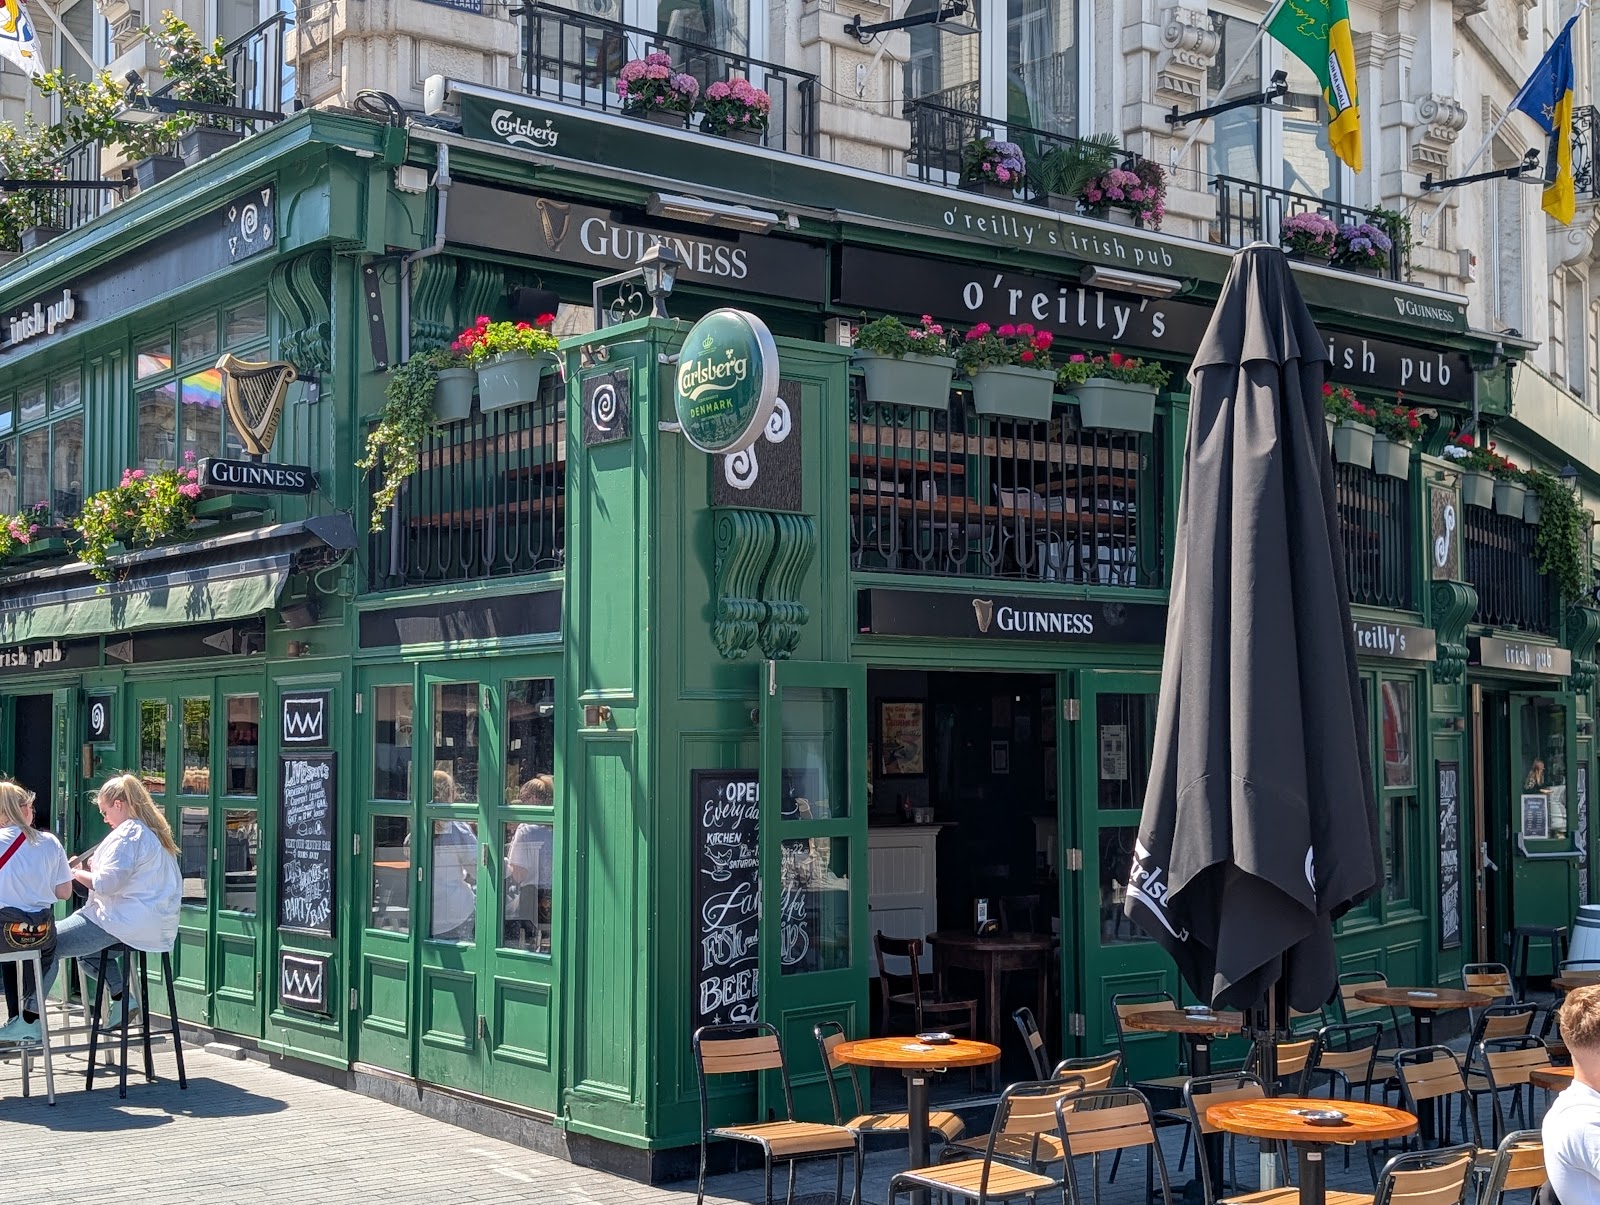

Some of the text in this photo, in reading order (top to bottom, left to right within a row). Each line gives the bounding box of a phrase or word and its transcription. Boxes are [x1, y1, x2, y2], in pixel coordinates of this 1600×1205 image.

[490, 108, 559, 147] Carlsberg
[944, 206, 1173, 267] o'reilly's irish pub
[10, 289, 75, 344] irish pub
[963, 274, 1166, 340] o'reilly's
[1405, 301, 1454, 323] GUINNESS
[1328, 337, 1451, 386] ish pub
[678, 356, 748, 401] Carlsberg
[690, 398, 733, 418] DENMARK
[212, 462, 305, 487] GUINNESS
[997, 606, 1093, 634] GUINNESS
[1353, 623, 1406, 655] 'reilly's
[0, 640, 62, 668] rish pub
[1505, 644, 1552, 671] irish pub
[284, 897, 312, 923] PARTY
[310, 898, 331, 927] BAR
